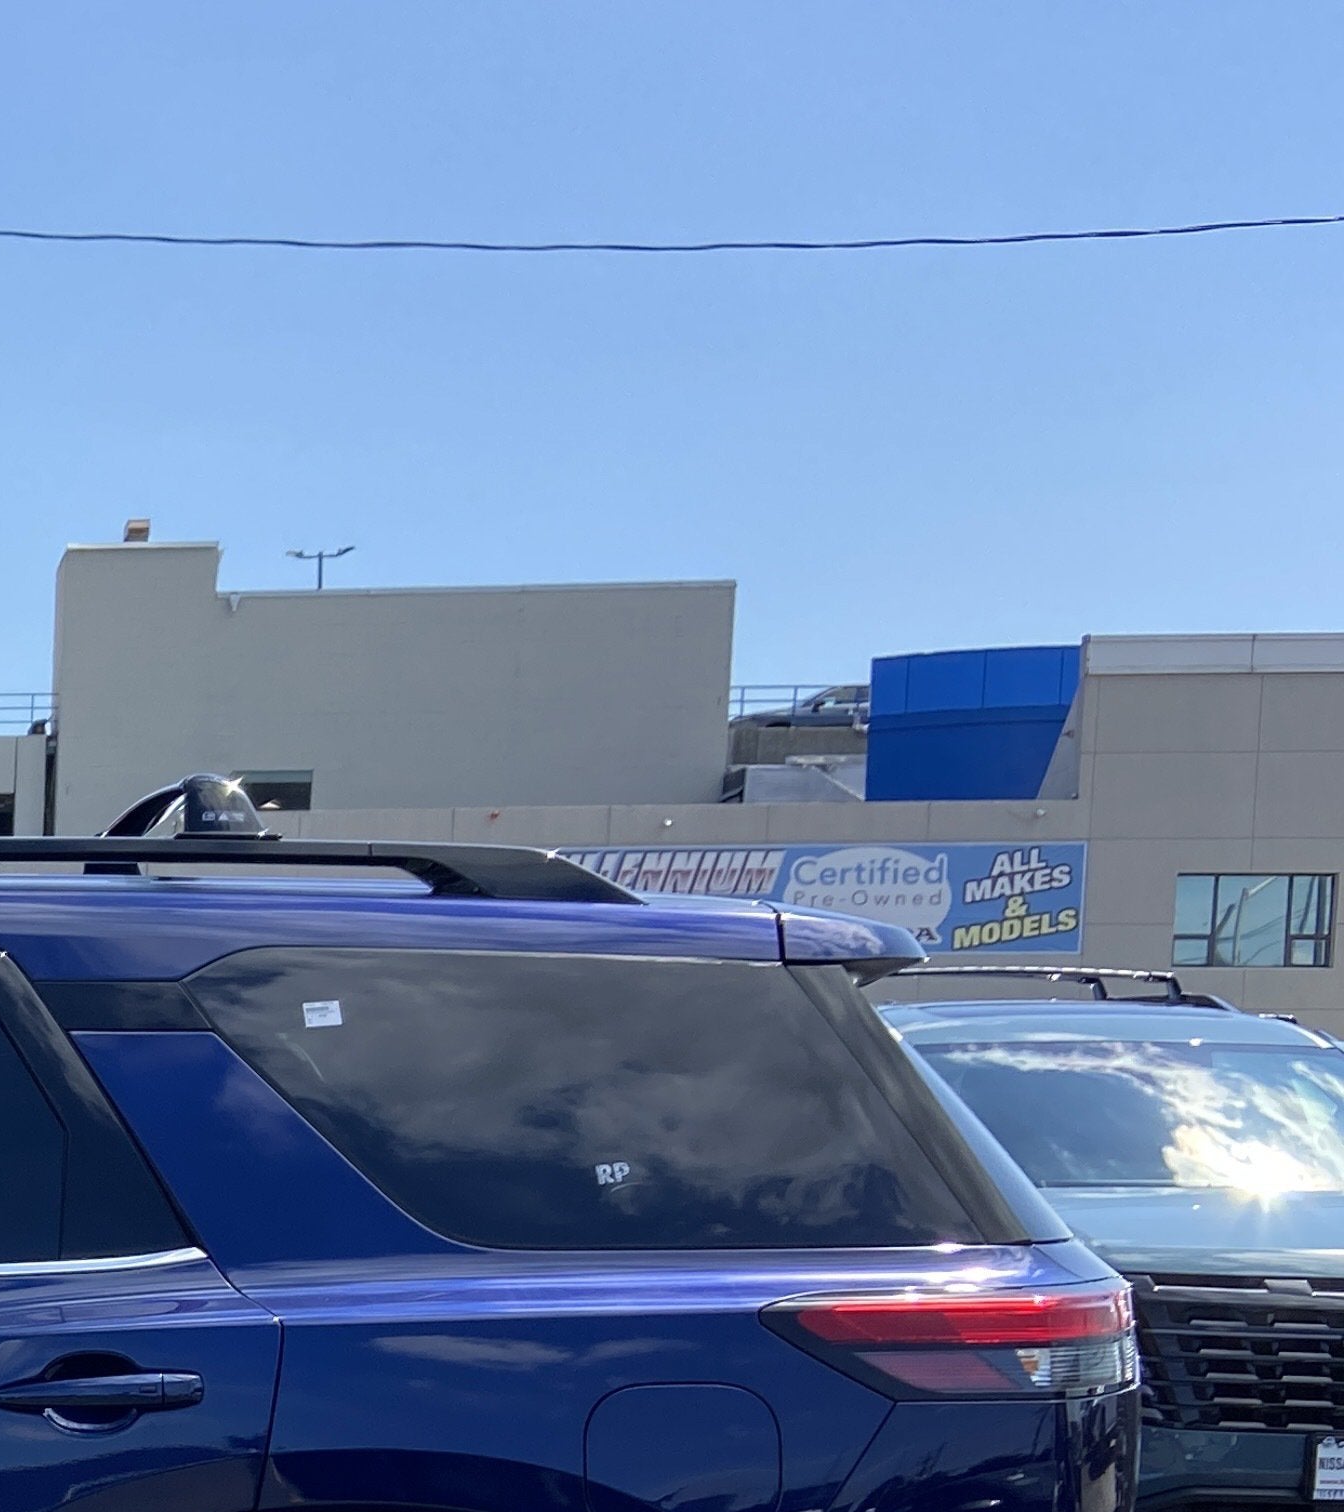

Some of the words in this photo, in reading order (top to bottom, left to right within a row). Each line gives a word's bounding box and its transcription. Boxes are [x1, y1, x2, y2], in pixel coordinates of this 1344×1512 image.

[794, 854, 946, 887] Certified
[990, 846, 1048, 877] ALL
[964, 863, 1073, 903] MAKES
[793, 889, 944, 907] Pre-Owned
[1004, 894, 1029, 918] &
[952, 908, 1078, 950] MODELS
[595, 1162, 630, 1185] RP
[1318, 1457, 1344, 1470] NISS
